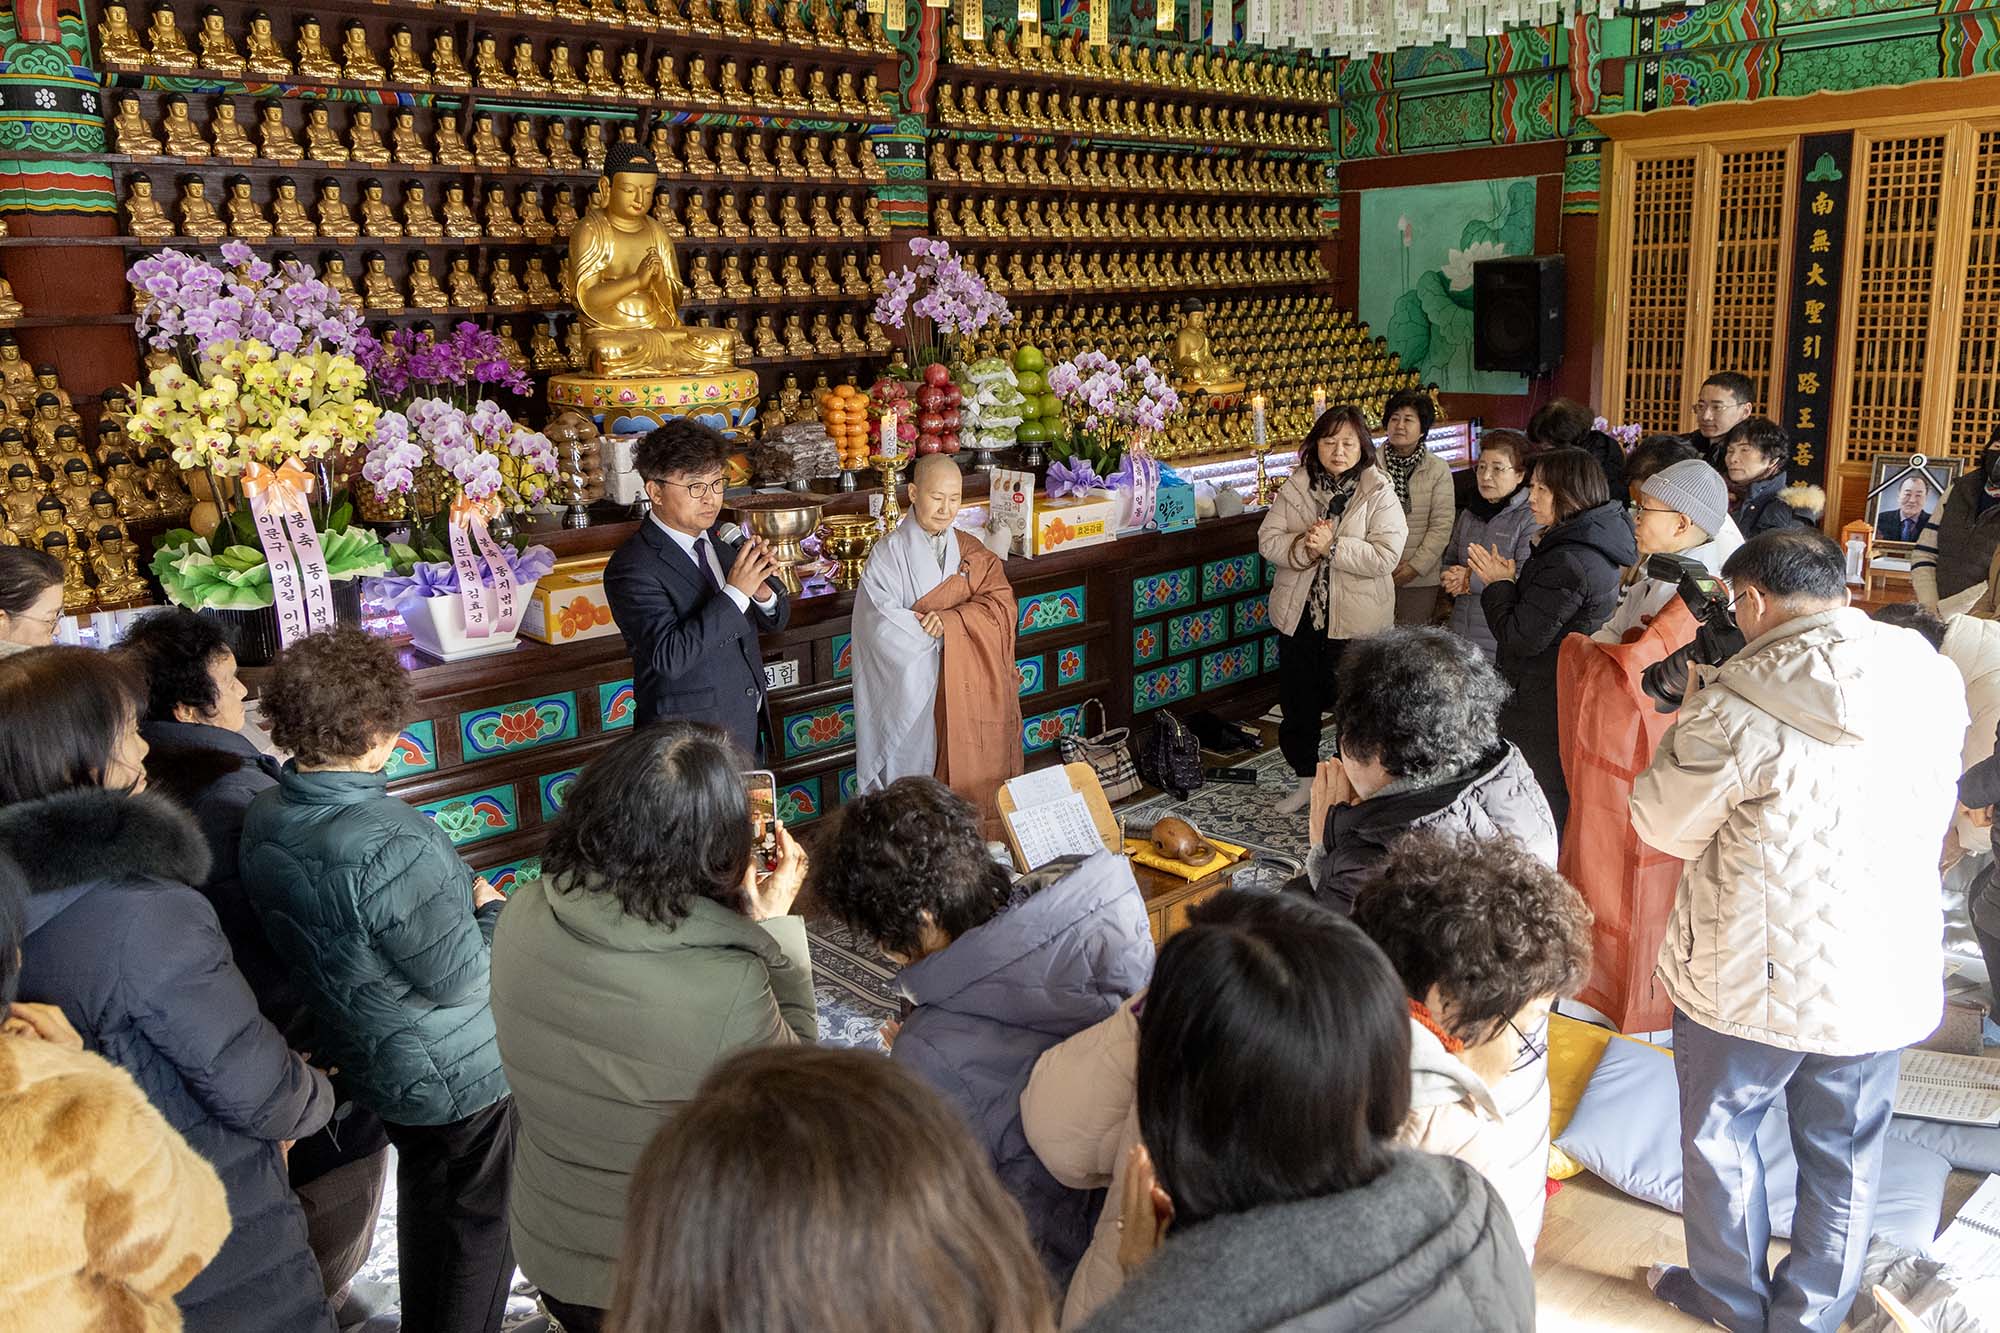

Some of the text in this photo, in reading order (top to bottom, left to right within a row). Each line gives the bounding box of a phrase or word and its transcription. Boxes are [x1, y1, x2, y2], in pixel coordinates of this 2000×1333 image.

[259, 513, 285, 553] 이문구
[290, 511, 327, 625] 봉축 동지법
[454, 536, 478, 582] 신도회장
[495, 565, 513, 618] 동지법회
